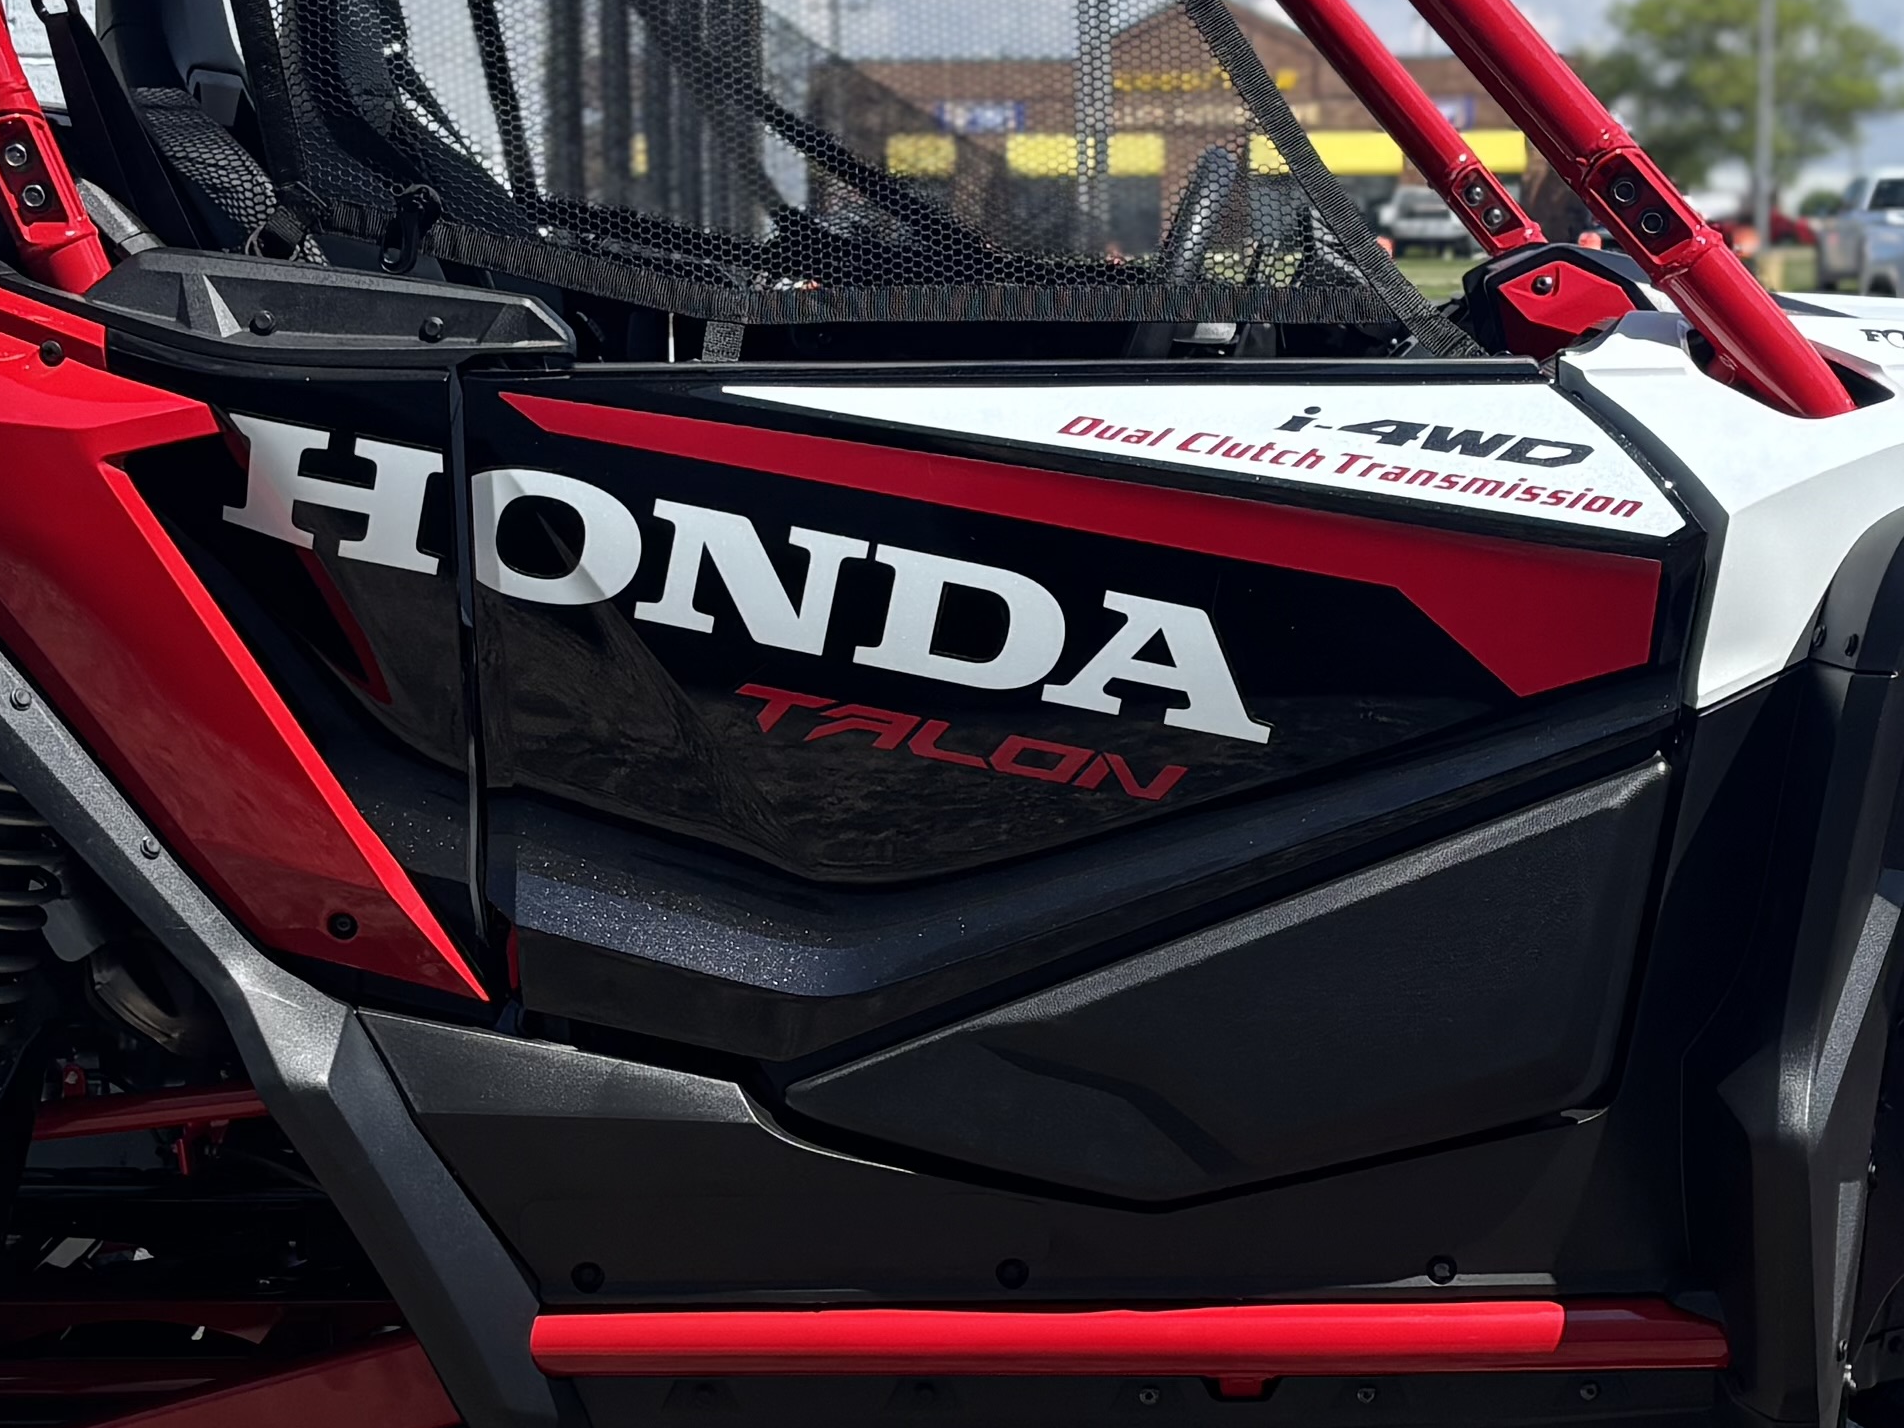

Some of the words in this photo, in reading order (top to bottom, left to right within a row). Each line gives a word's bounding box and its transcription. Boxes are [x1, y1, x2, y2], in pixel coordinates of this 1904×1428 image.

[1056, 415, 1175, 447] Dual
[1175, 432, 1326, 470] Clutch
[1333, 452, 1644, 518] Transmission
[1276, 406, 1594, 468] i-4WD
[222, 413, 1272, 745] HONDA
[735, 682, 1188, 804] TALON
